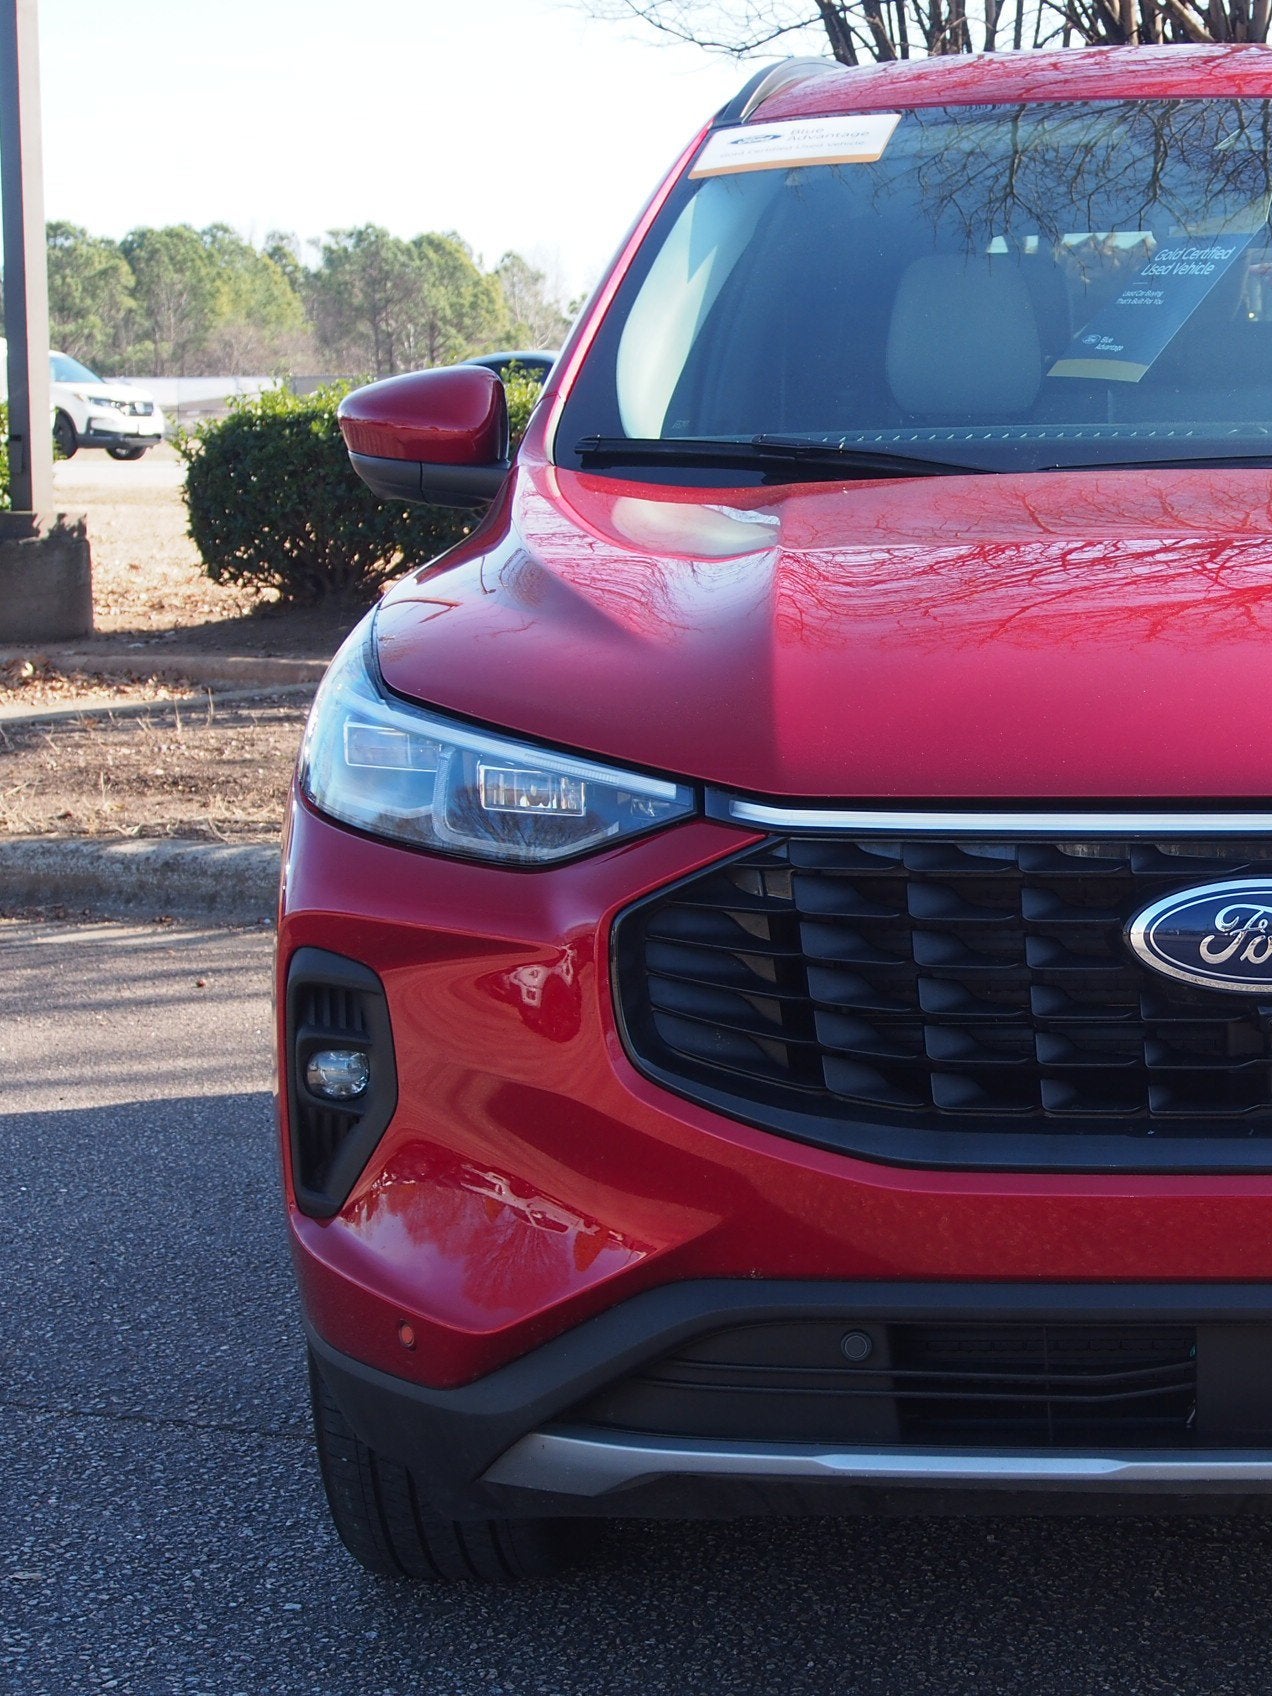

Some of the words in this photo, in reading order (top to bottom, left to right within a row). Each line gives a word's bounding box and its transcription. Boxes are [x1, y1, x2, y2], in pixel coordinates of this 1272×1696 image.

[1154, 247, 1187, 261] Gold
[1182, 246, 1236, 260] Certified
[1140, 261, 1176, 275] Used
[1172, 261, 1216, 275] Vehicle
